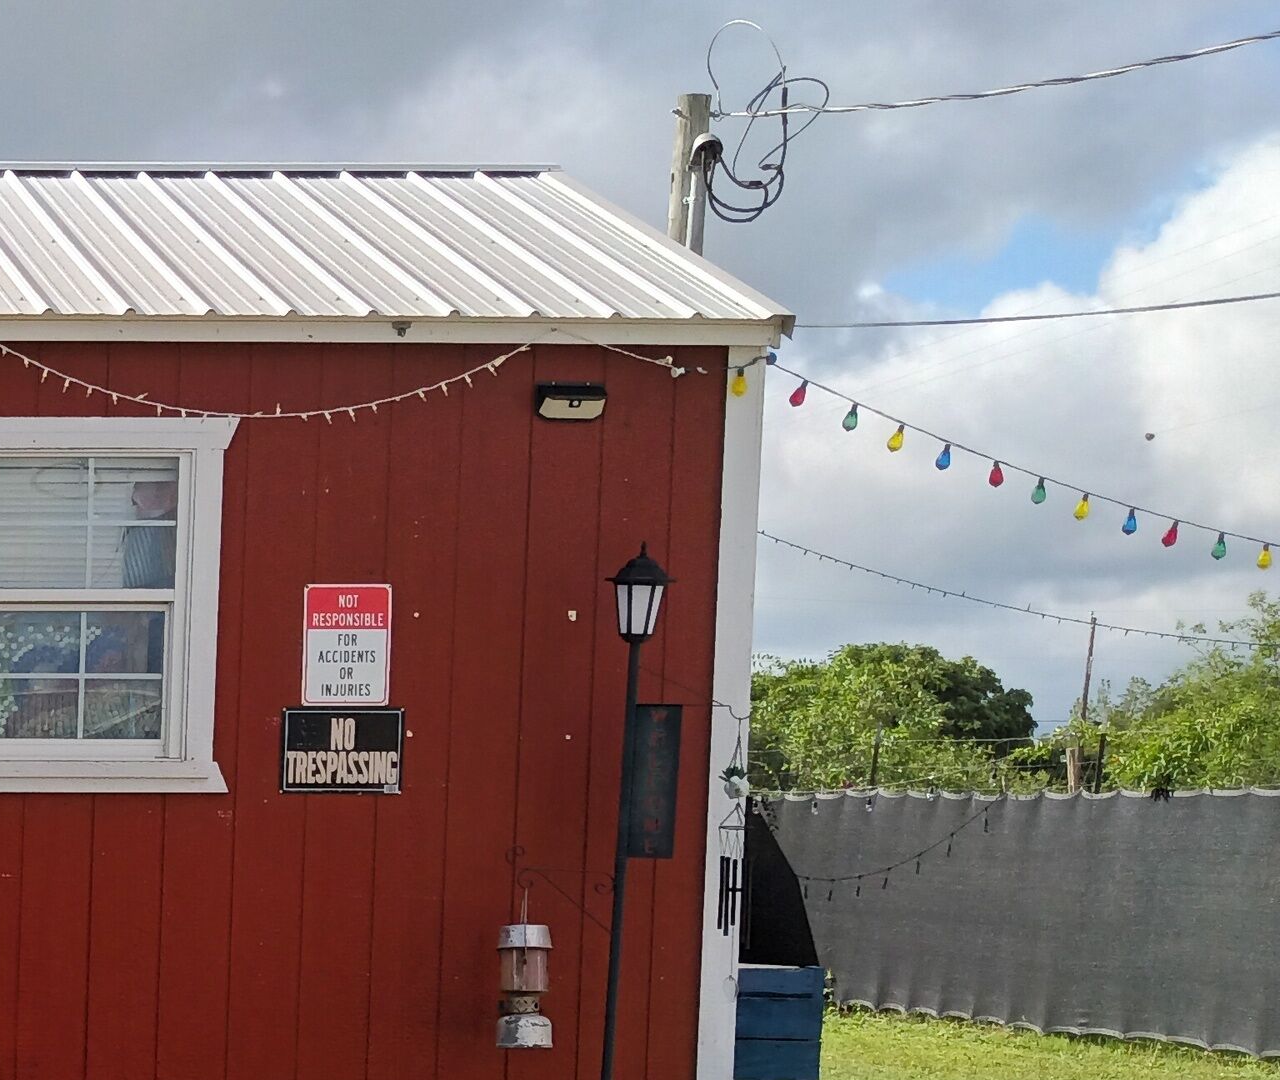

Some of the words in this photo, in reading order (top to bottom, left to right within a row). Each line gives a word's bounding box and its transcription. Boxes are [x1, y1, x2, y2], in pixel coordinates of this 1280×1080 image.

[338, 594, 359, 608] NOT
[312, 613, 384, 626] RESPONSIBLE
[337, 633, 358, 646] FOR
[318, 650, 376, 663] ACCIDENTS
[340, 667, 353, 680] OR
[321, 683, 371, 696] INJURIES
[330, 718, 356, 751] NO
[287, 751, 398, 784] TRESPASSING
